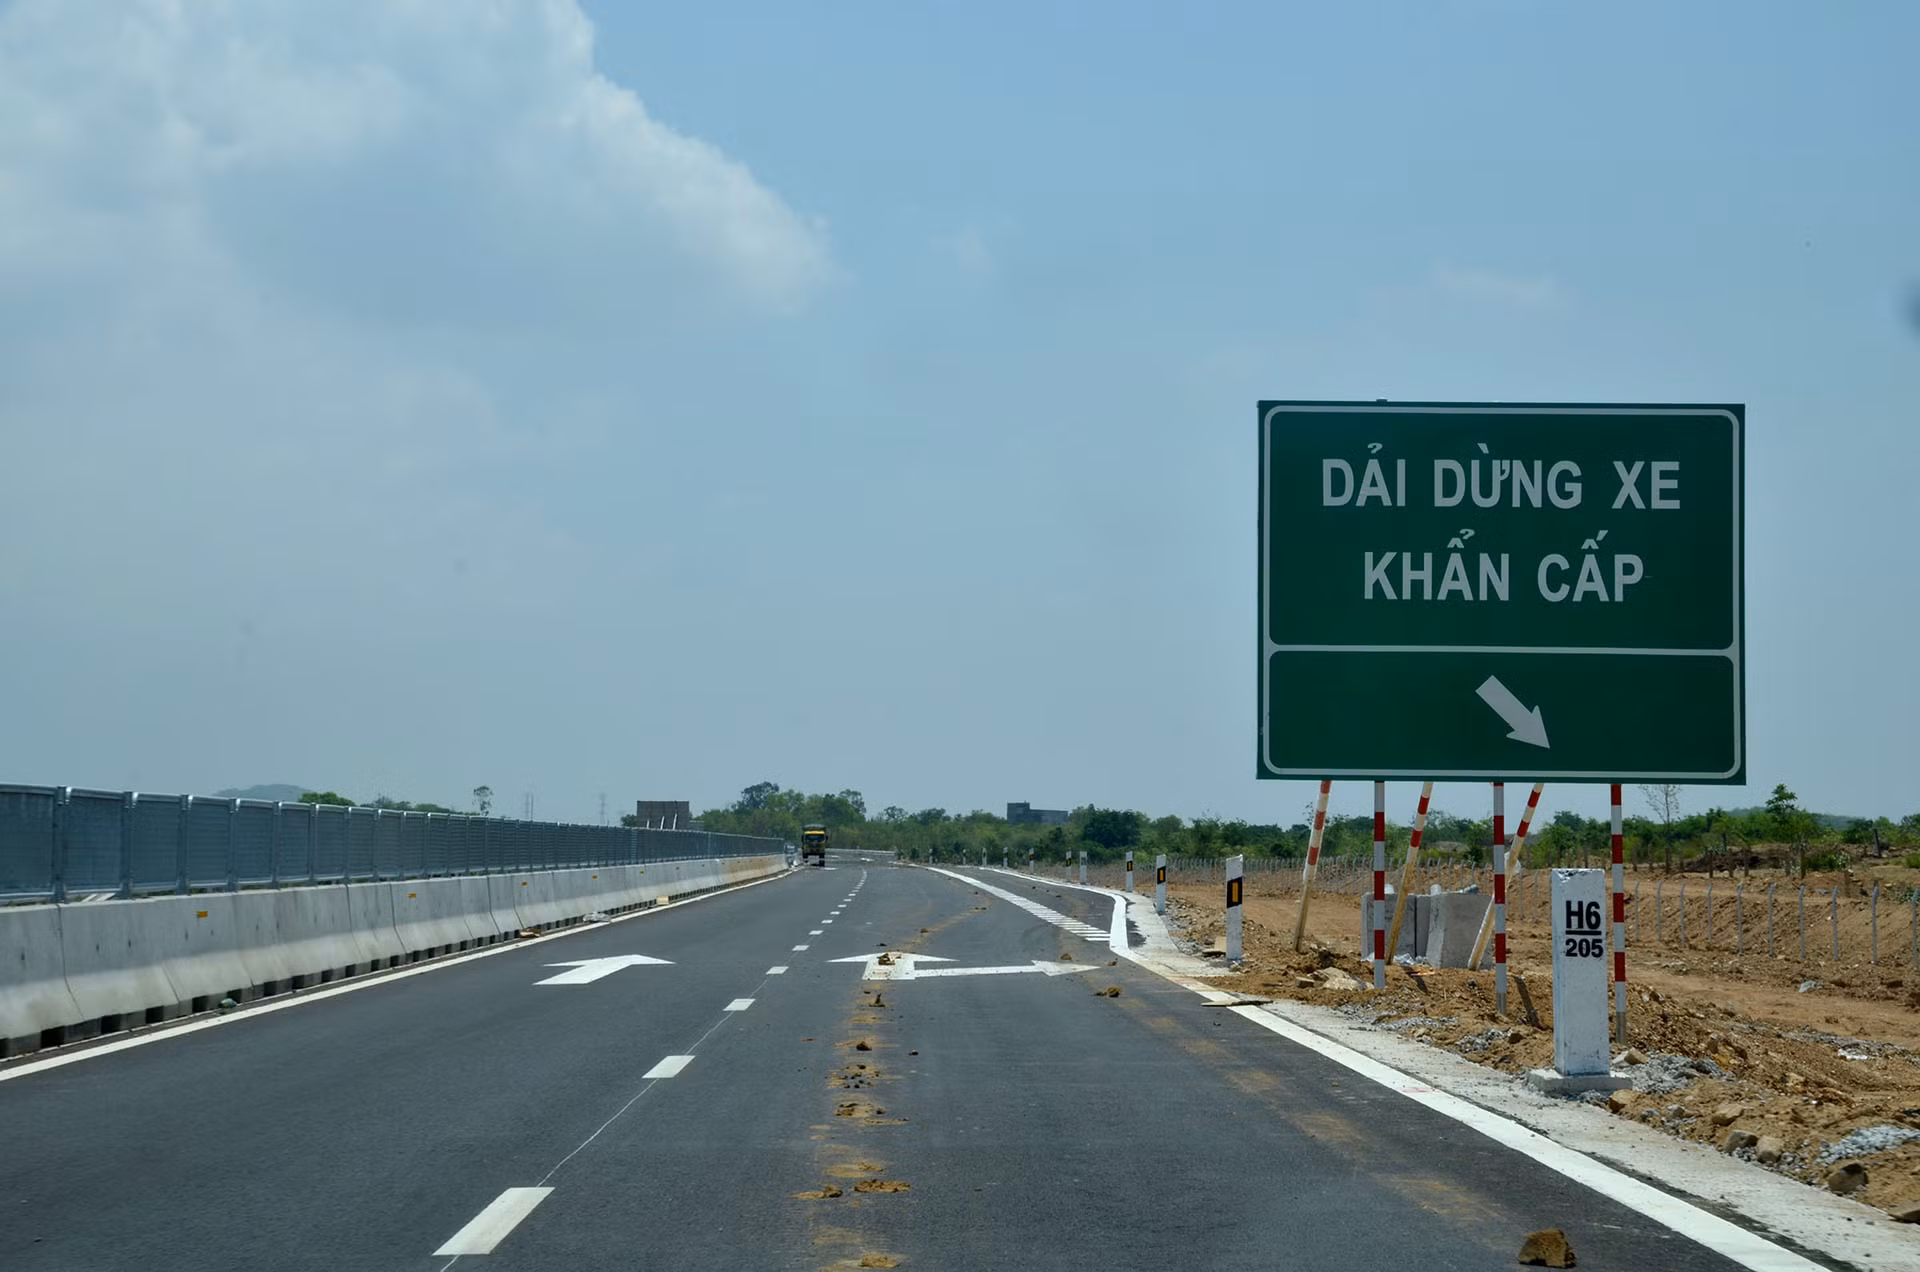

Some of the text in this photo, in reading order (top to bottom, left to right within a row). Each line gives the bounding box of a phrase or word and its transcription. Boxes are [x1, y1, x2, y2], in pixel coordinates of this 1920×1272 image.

[1321, 442, 1681, 510] DẢI DỪNG XE
[1363, 528, 1645, 602] KHẨN CẤP
[1565, 900, 1602, 930] H6
[1565, 938, 1604, 958] 205
